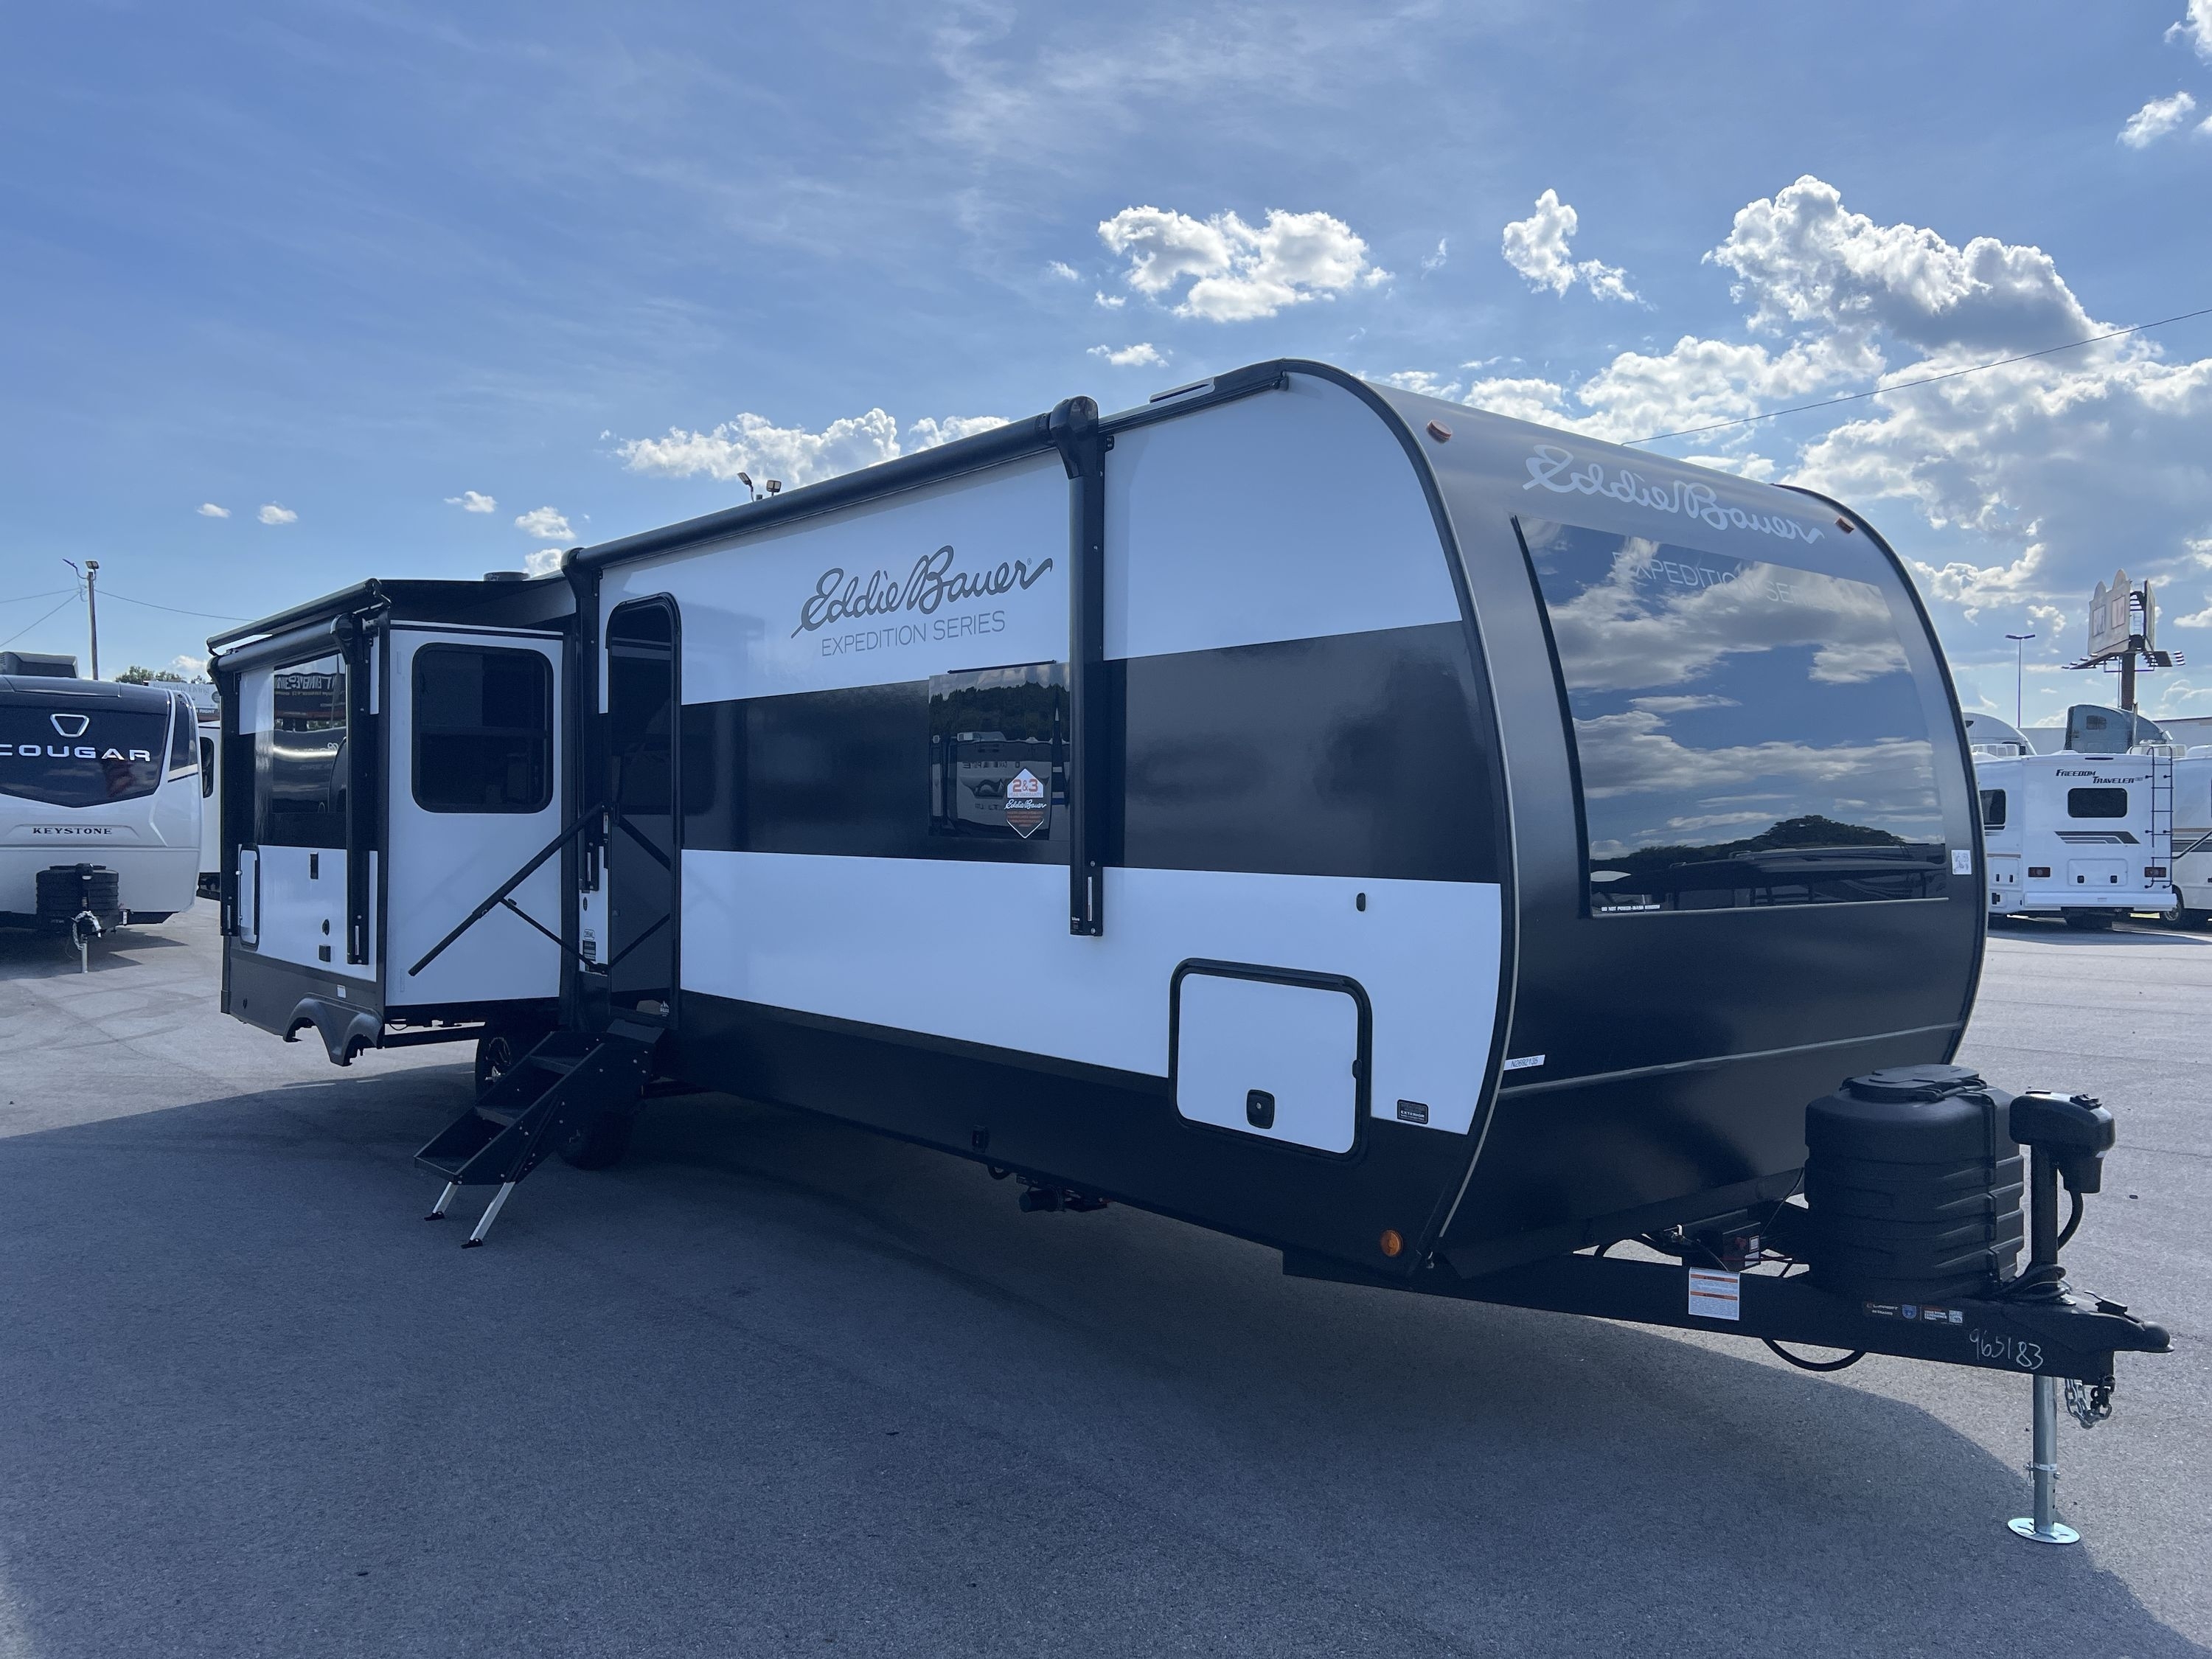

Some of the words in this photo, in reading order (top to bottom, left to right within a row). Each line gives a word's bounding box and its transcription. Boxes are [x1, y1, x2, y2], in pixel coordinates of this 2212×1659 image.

[821, 622, 927, 657] EXPEDITION
[933, 610, 1006, 641] SERIES
[2093, 776, 2135, 784] TRAVELER
[32, 827, 113, 835] KEYSTONE
[1400, 1110, 1425, 1118] EXTERIOR
